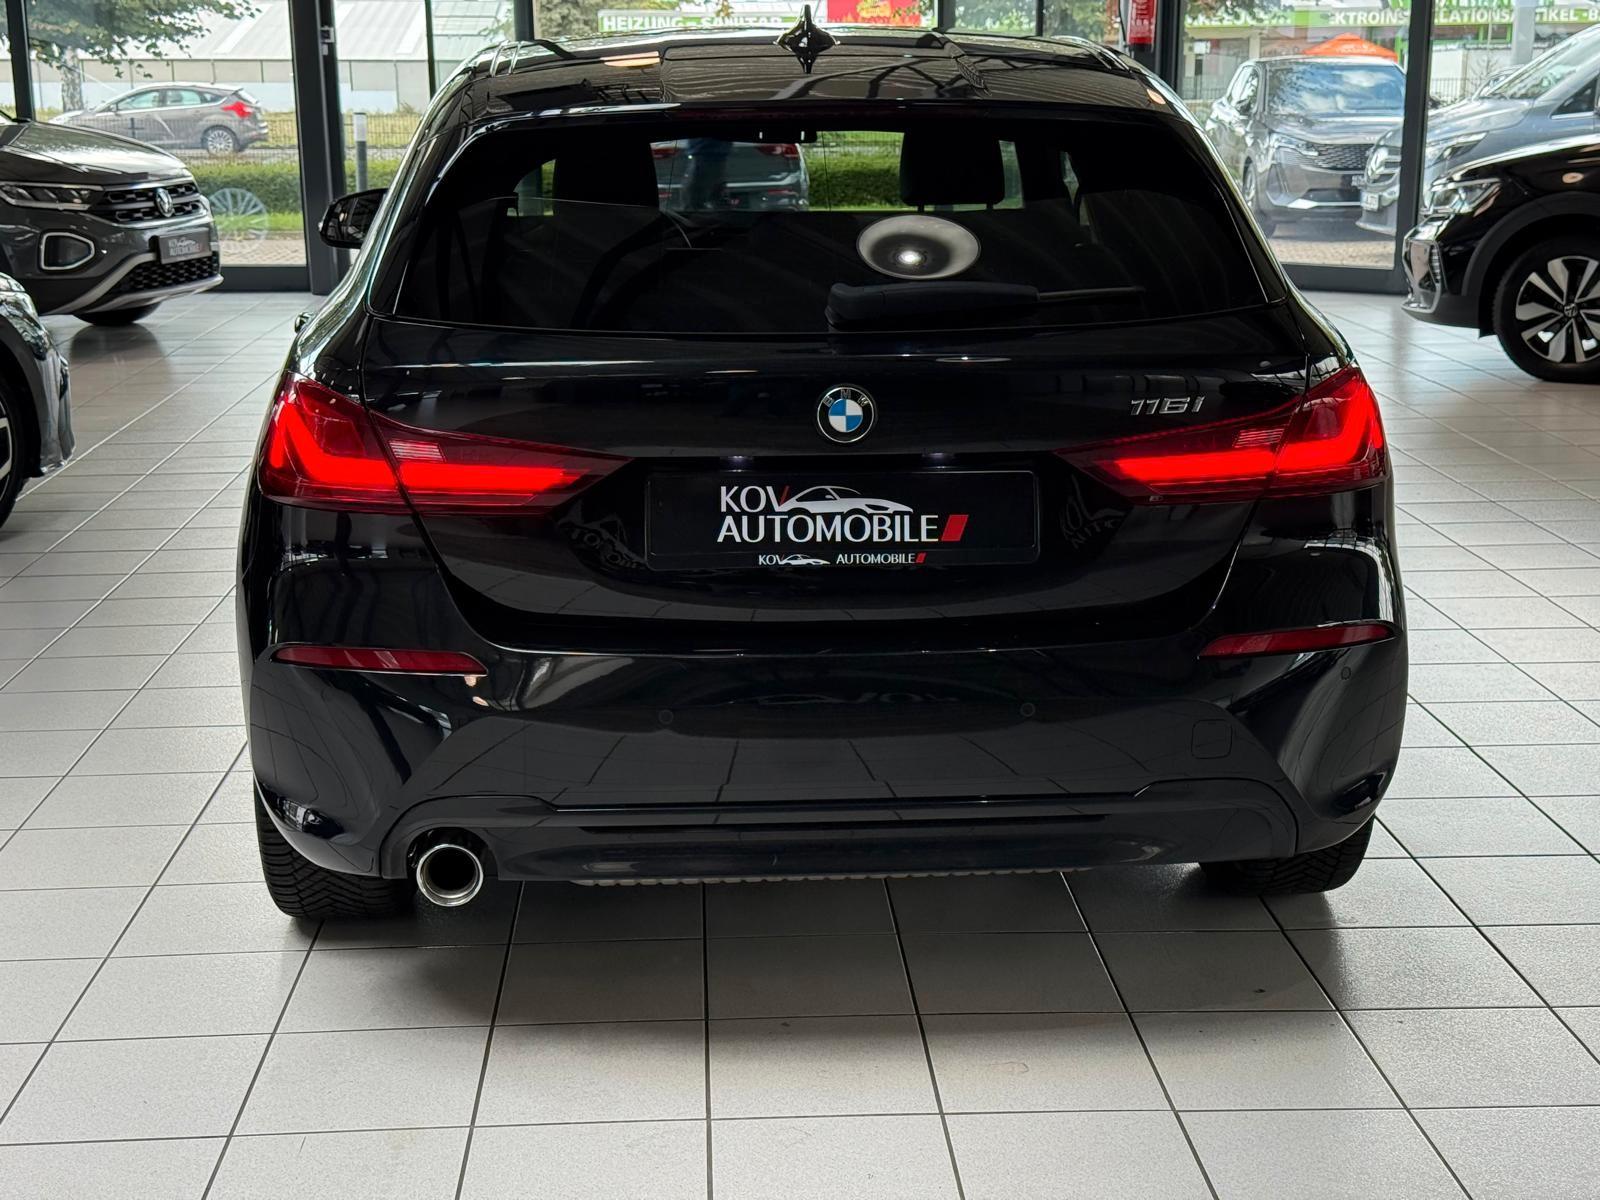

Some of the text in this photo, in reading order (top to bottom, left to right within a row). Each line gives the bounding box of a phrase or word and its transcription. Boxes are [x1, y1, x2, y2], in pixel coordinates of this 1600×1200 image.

[603, 16, 683, 32] HEIZUNG
[720, 485, 789, 513] KOV
[717, 514, 939, 542] AUTOMOBILE
[836, 553, 915, 565] AUTOMOBILE
